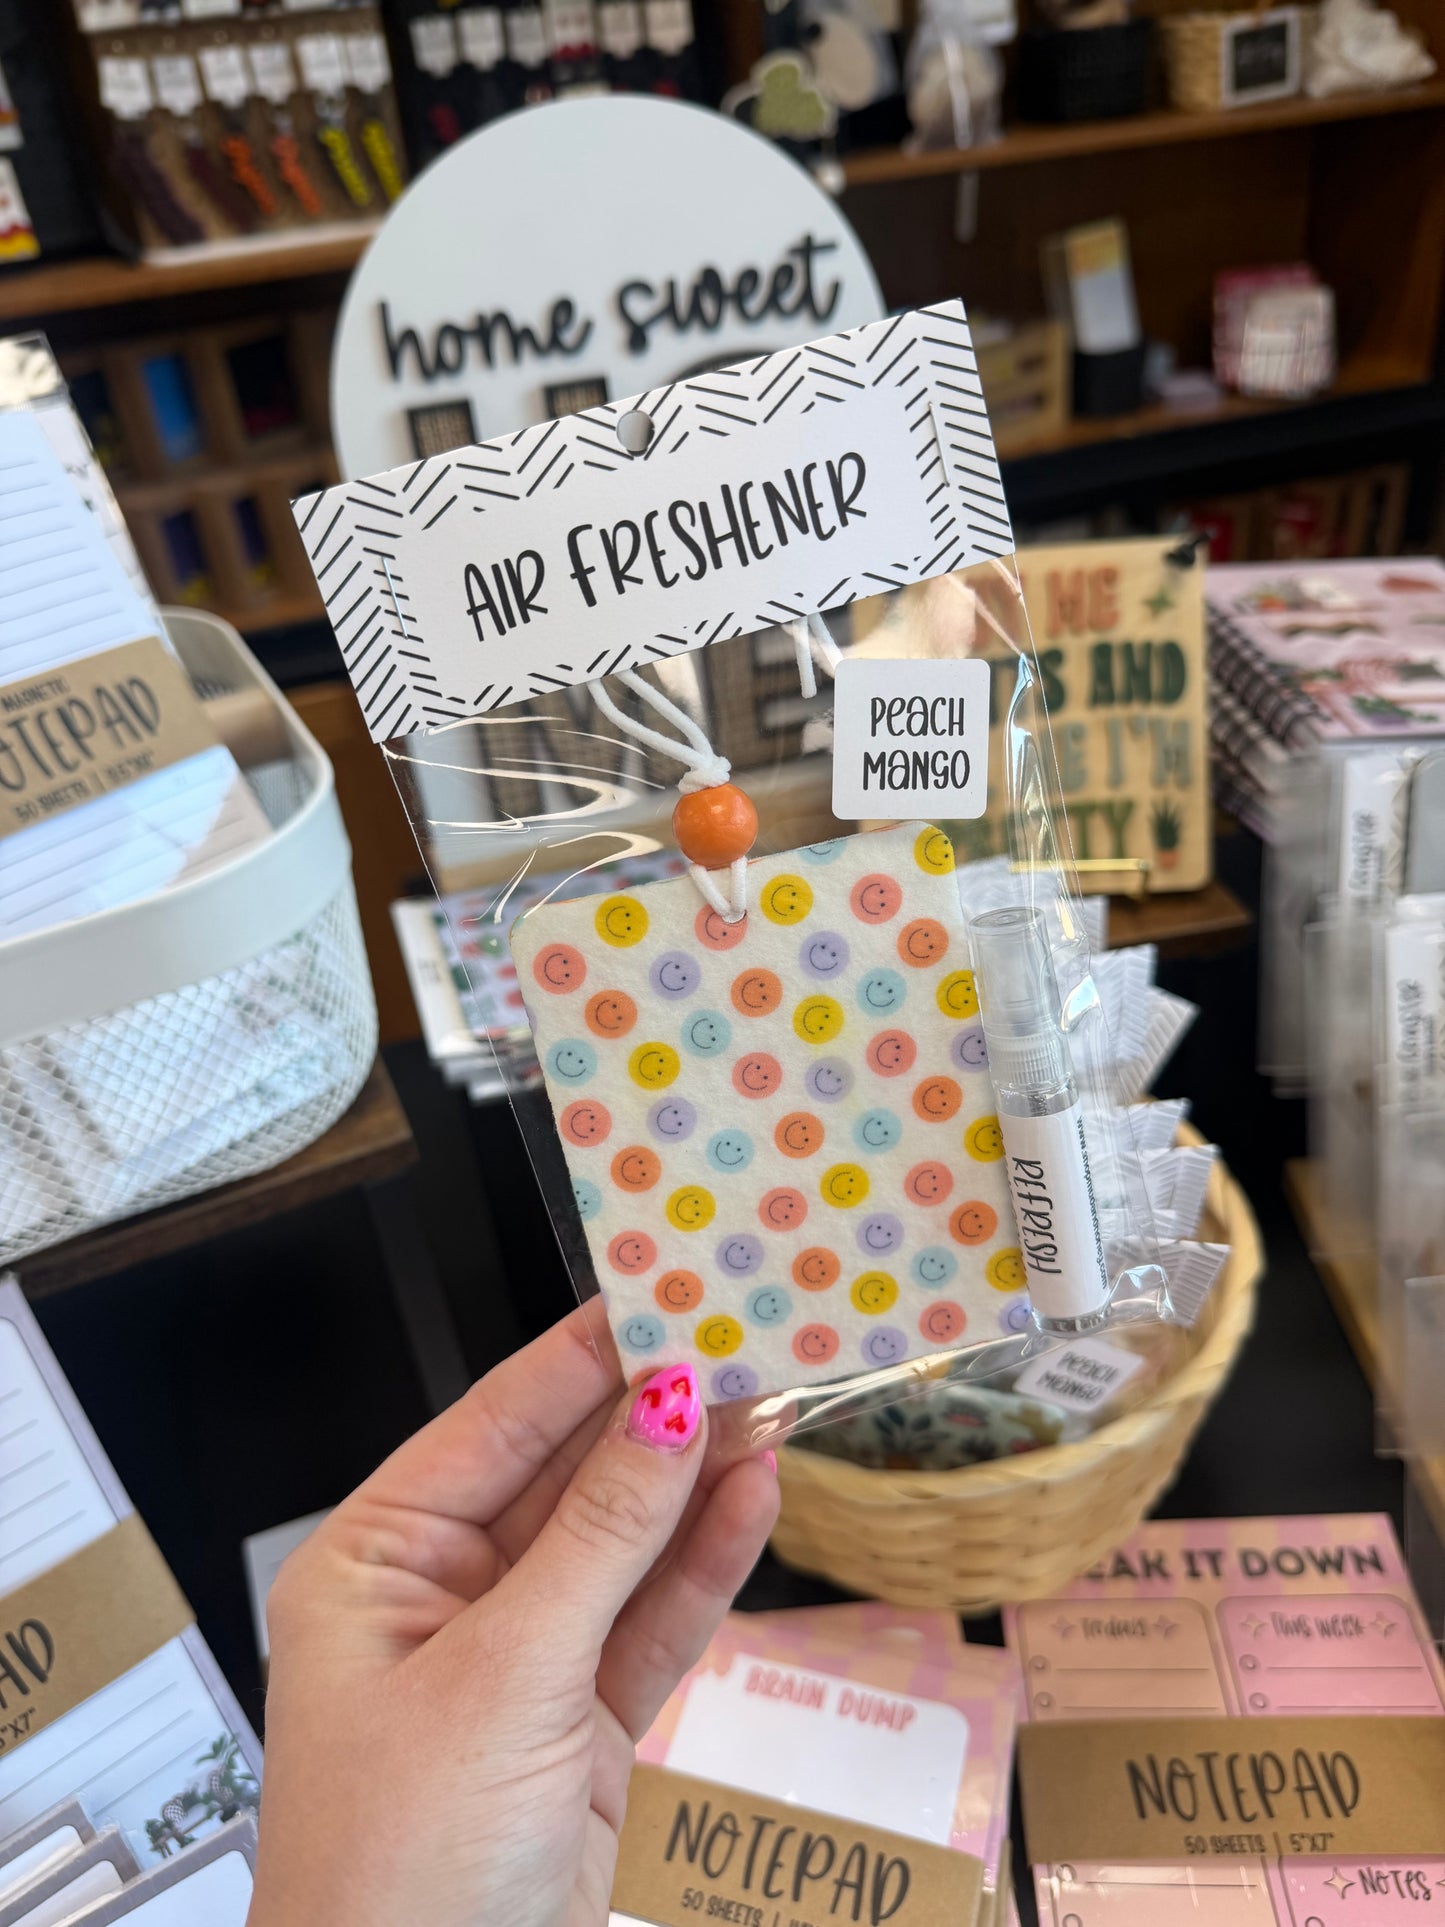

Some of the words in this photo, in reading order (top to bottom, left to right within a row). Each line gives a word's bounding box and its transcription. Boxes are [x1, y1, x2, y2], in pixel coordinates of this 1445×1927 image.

[379, 296, 594, 381] home
[616, 235, 840, 353] sweet
[464, 549, 549, 642] AIR
[567, 452, 868, 608] FRESHENER
[1045, 565, 1120, 637] ME
[1088, 640, 1187, 709] AND
[1011, 1156, 1063, 1275] REFRESH
[1183, 1548, 1223, 1579] IT
[1238, 1545, 1386, 1579] DOWN
[744, 1664, 828, 1711] BRAIN
[836, 1686, 919, 1733] DUMP
[1126, 1747, 1361, 1823] NOTEPAD
[664, 1800, 911, 1927] NOTEPAD
[1184, 1835, 1206, 1854] 50
[1210, 1834, 1266, 1853] SHEETS
[681, 1887, 705, 1911] 50
[705, 1894, 764, 1927] SHEETS
